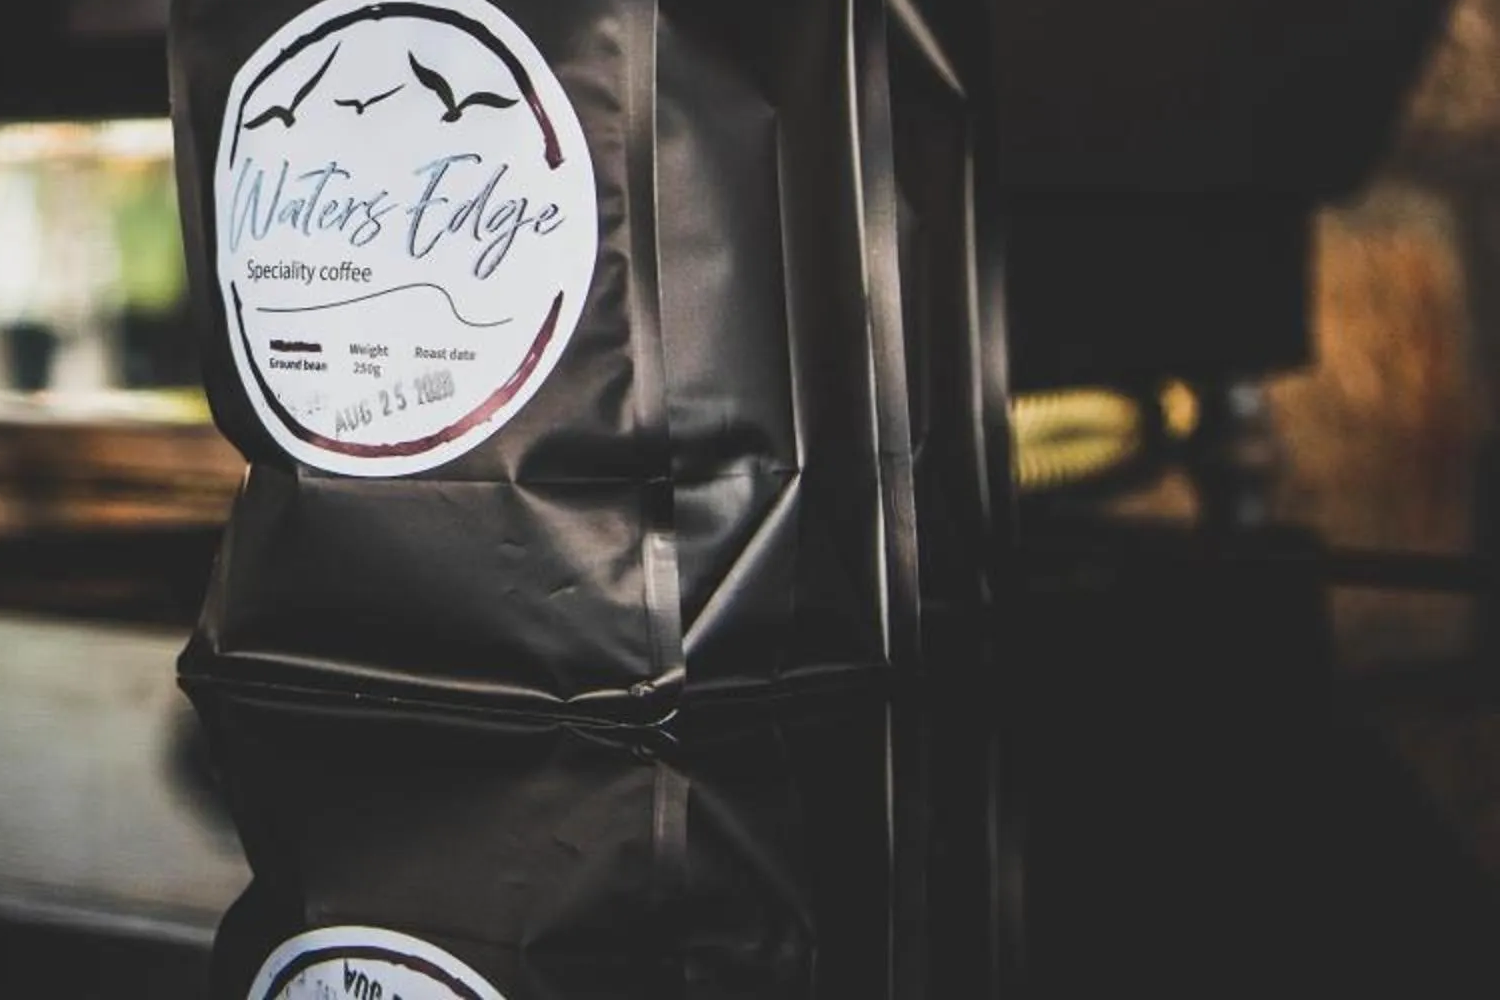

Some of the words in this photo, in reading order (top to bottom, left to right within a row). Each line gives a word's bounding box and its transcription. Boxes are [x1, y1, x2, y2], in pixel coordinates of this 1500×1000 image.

[230, 157, 398, 251] Waters
[405, 153, 565, 280] Edge
[247, 258, 316, 286] Speciality
[319, 260, 373, 282] coffee
[349, 343, 389, 359] Weight
[414, 346, 447, 360] Roast
[449, 347, 476, 361] date
[269, 358, 302, 371] Ground
[303, 359, 328, 372] bean
[336, 402, 373, 434] AUG
